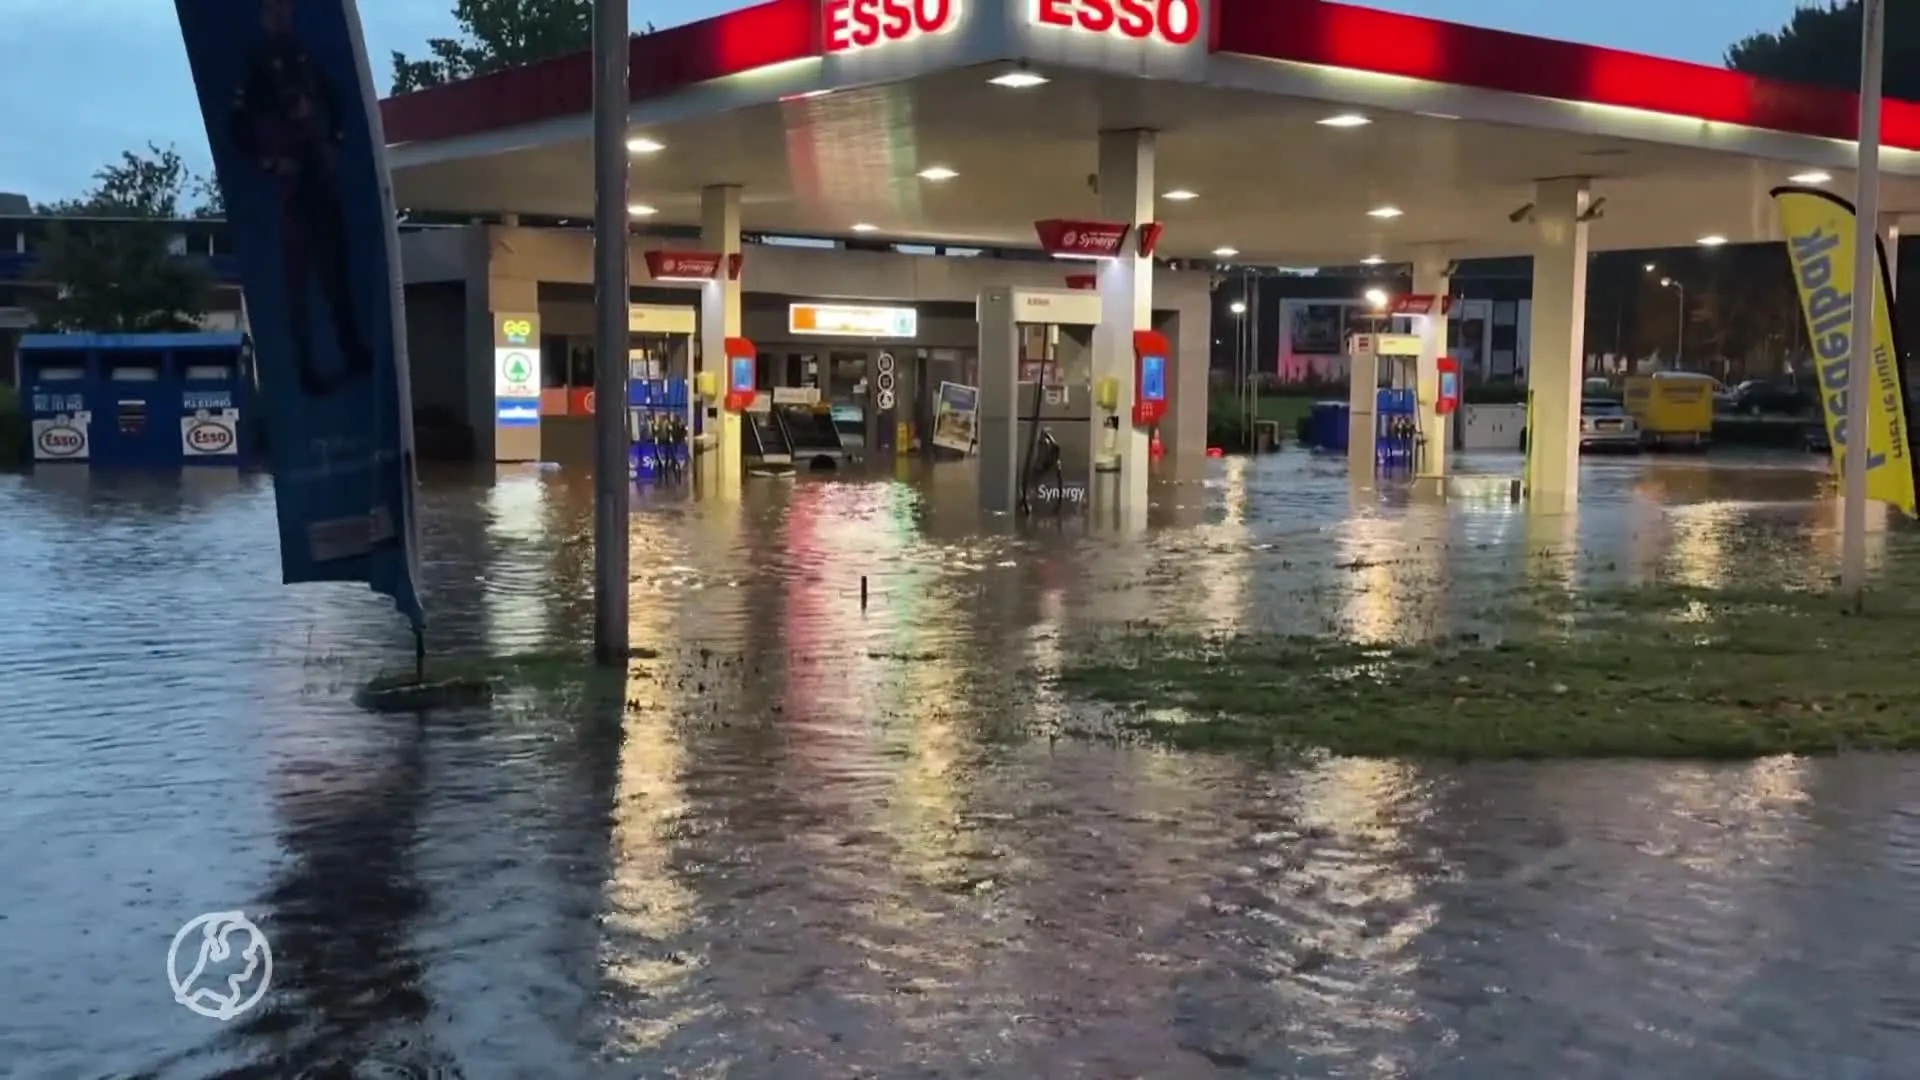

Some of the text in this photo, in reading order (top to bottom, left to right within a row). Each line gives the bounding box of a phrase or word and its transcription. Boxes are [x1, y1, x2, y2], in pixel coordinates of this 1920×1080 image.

[826, 0, 950, 51] ESSO
[1039, 0, 1200, 44] ESSO
[45, 433, 78, 447] Esso
[194, 431, 226, 445] Esso
[1038, 483, 1085, 502] Synergy
